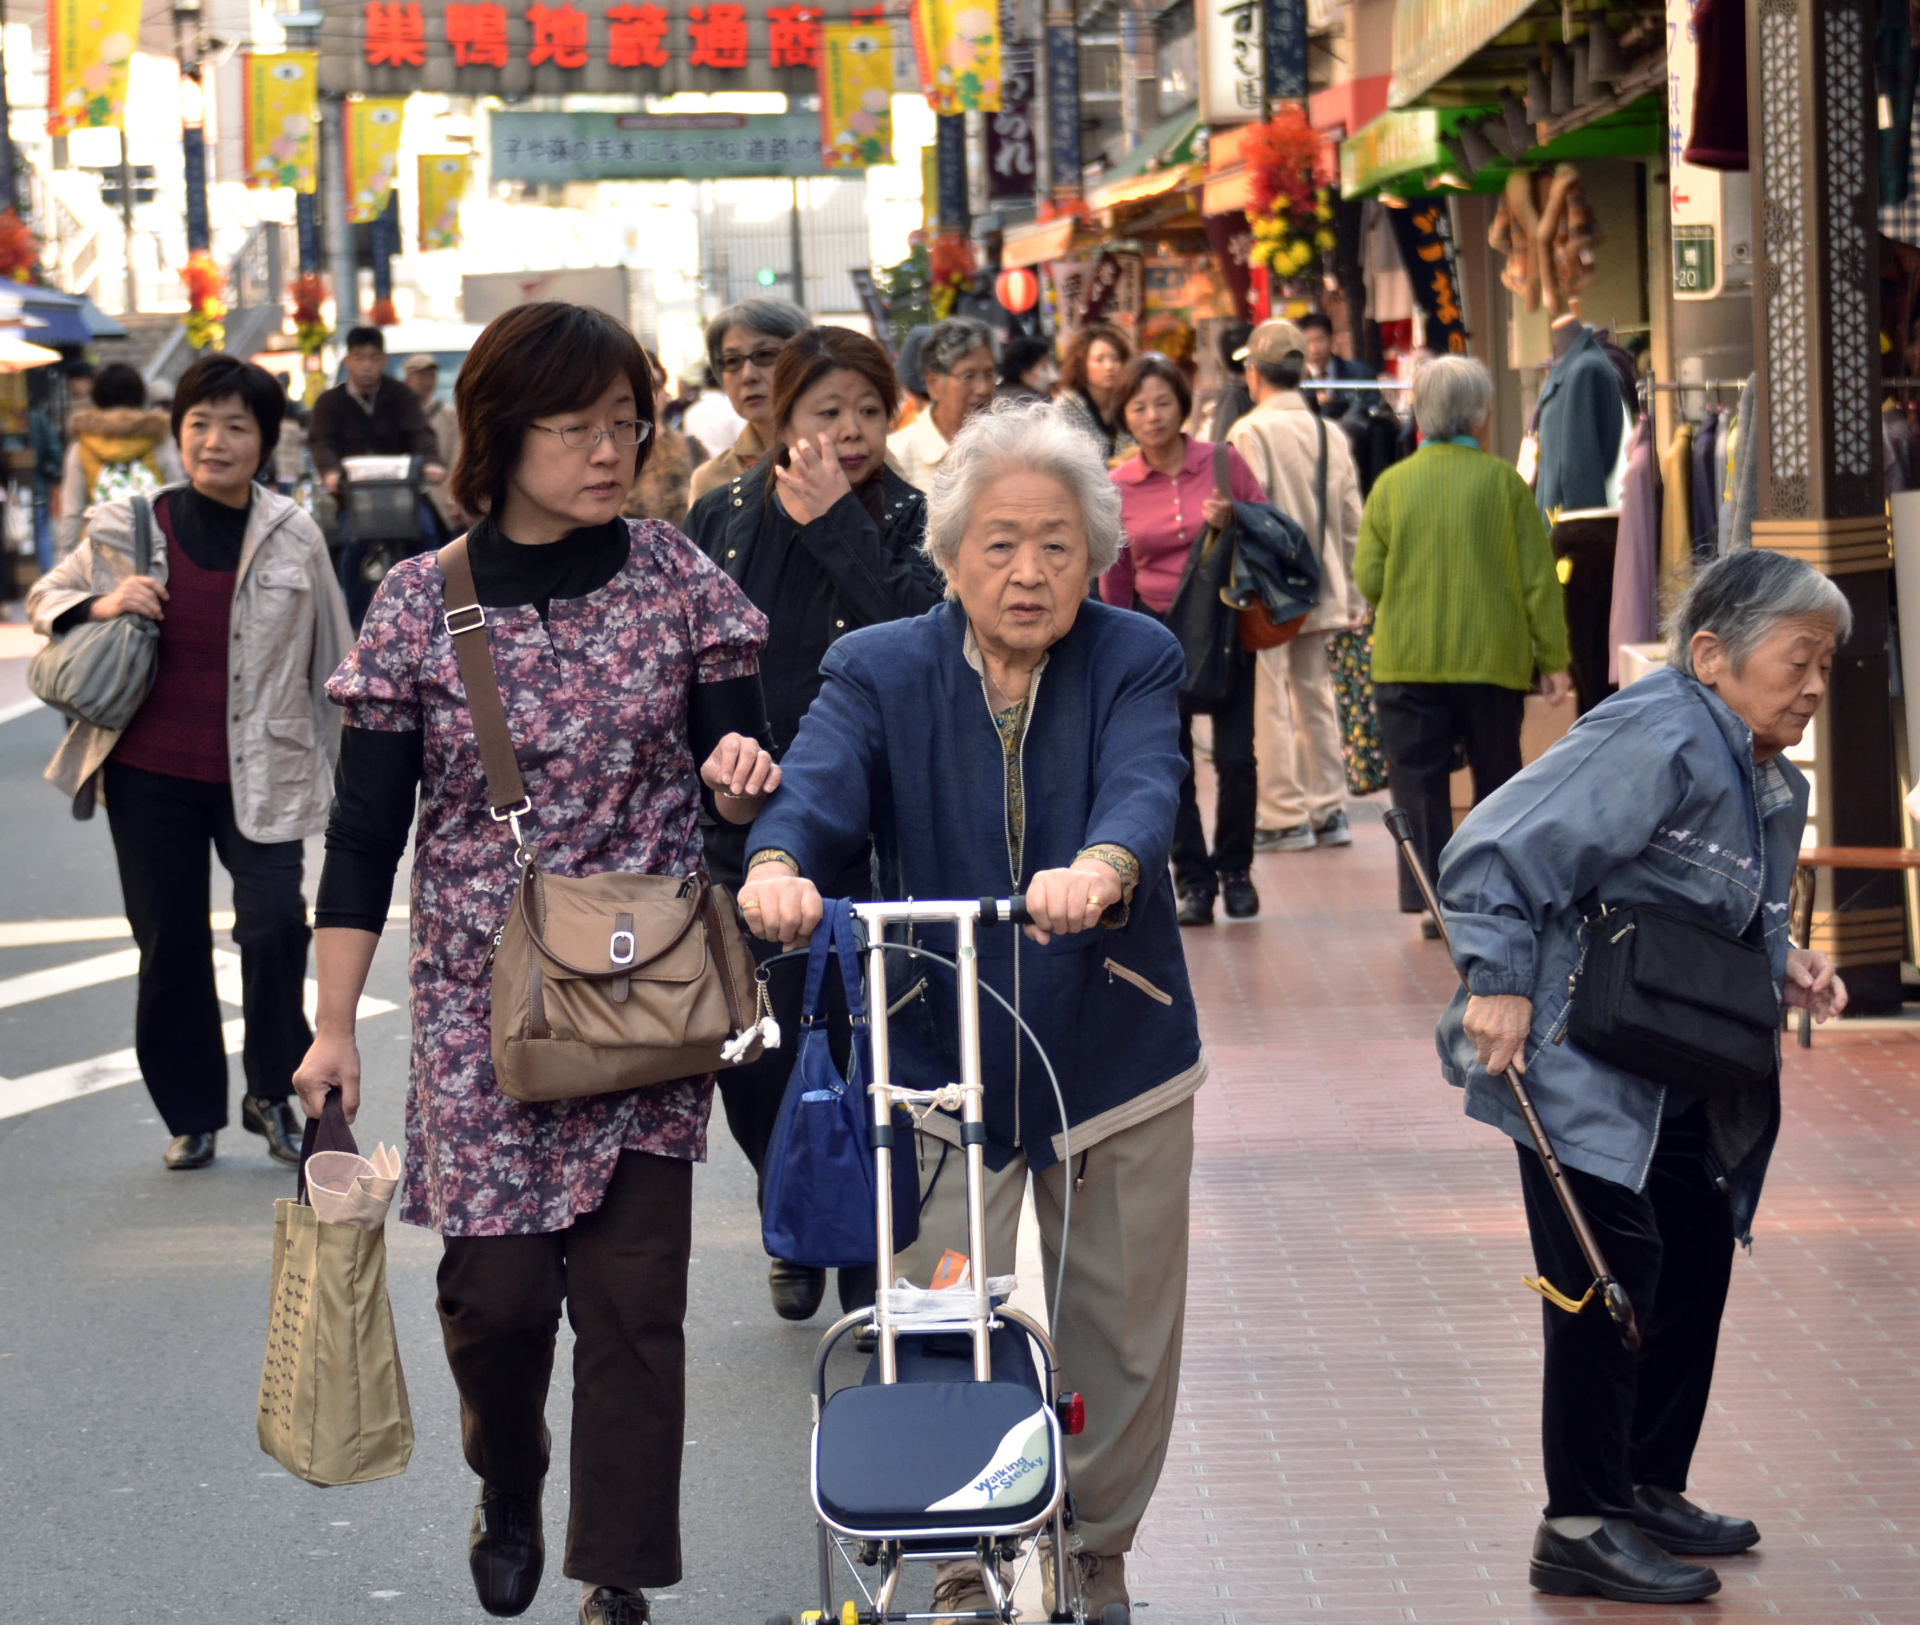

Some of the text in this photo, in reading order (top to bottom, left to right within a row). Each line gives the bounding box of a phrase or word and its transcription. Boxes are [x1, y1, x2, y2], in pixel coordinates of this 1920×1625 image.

[364, 2, 884, 68] 巣鴨地蔵通商
[973, 1456, 1028, 1501] Walking
[999, 1455, 1044, 1490] Stecky
